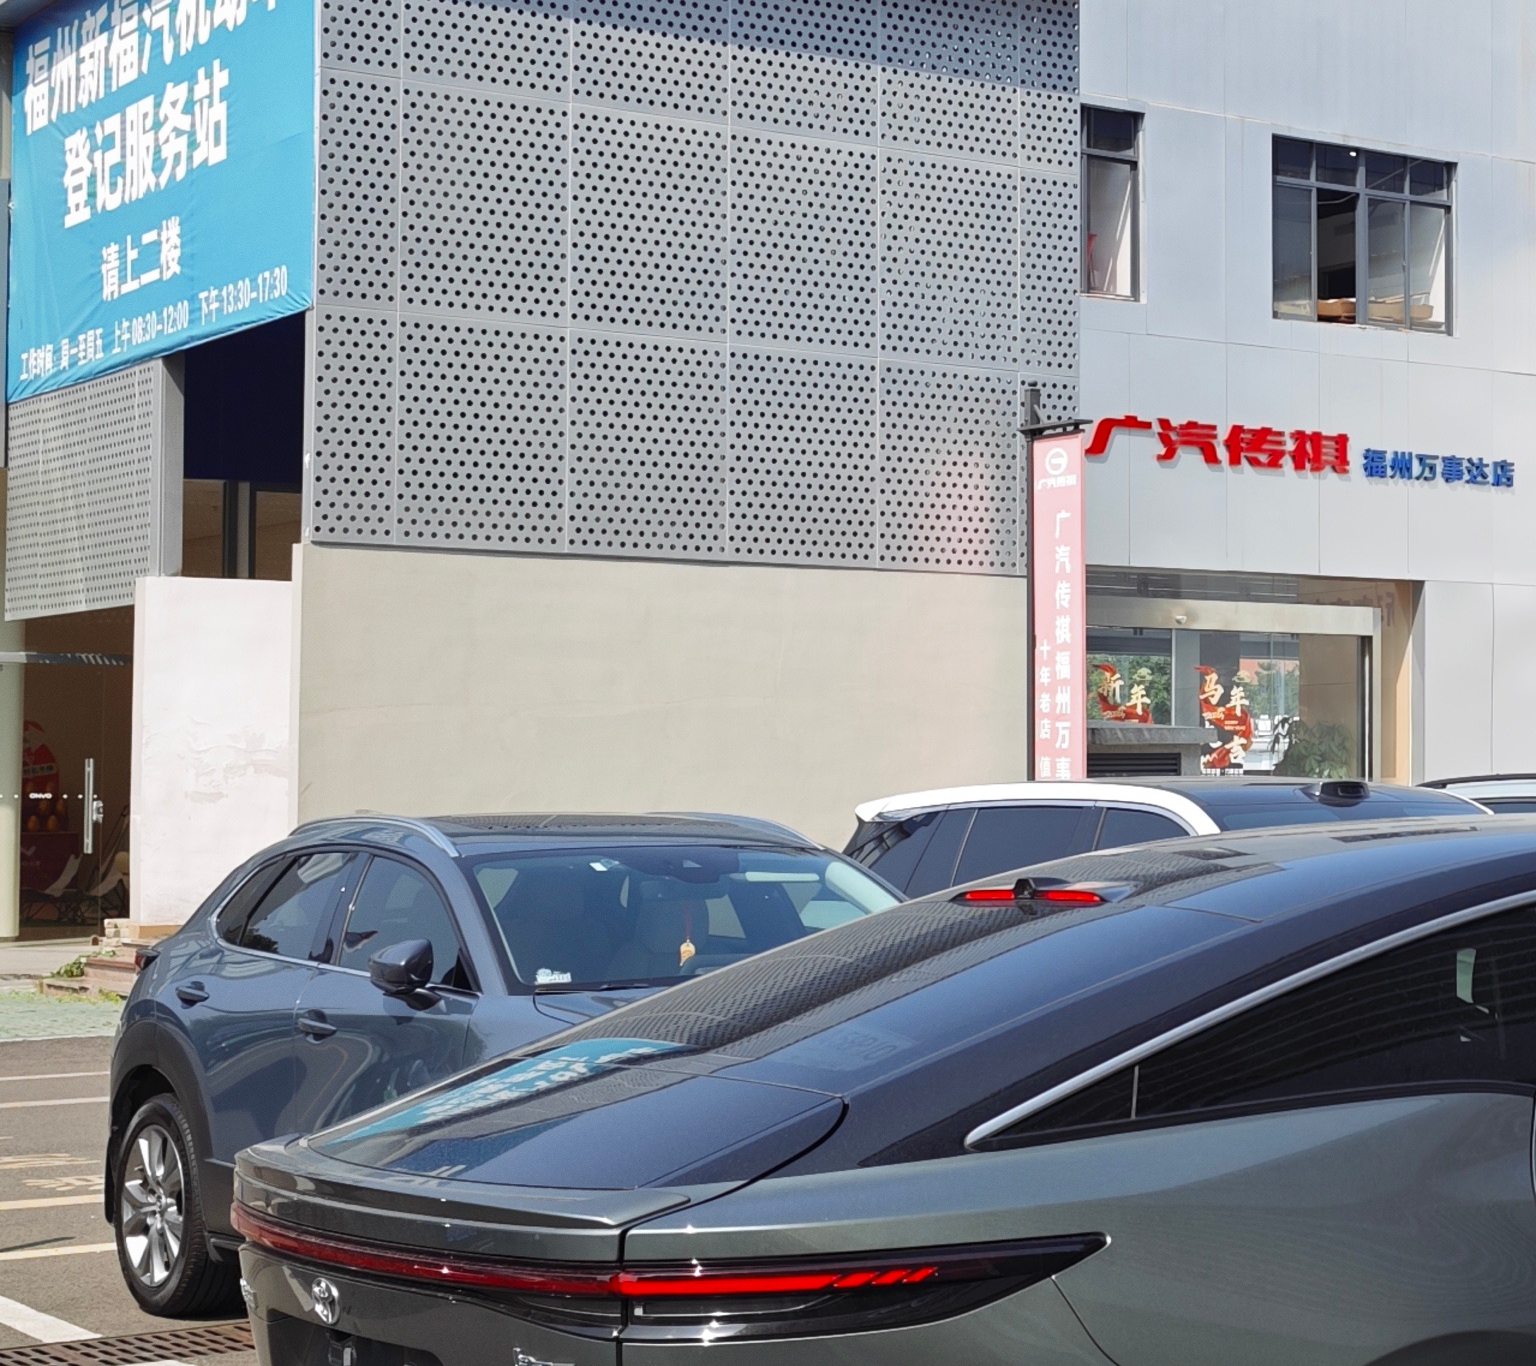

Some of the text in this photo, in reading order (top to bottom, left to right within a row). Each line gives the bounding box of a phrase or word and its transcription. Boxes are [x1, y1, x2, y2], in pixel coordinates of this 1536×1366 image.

[63, 59, 230, 229] 登记服务站
[101, 216, 181, 302] 请上二楼
[1085, 415, 1516, 488] 广汽传祺 福州万事达店
[1038, 639, 1051, 740] 十年老店
[1054, 510, 1072, 780] 广汽传祺福州万事
